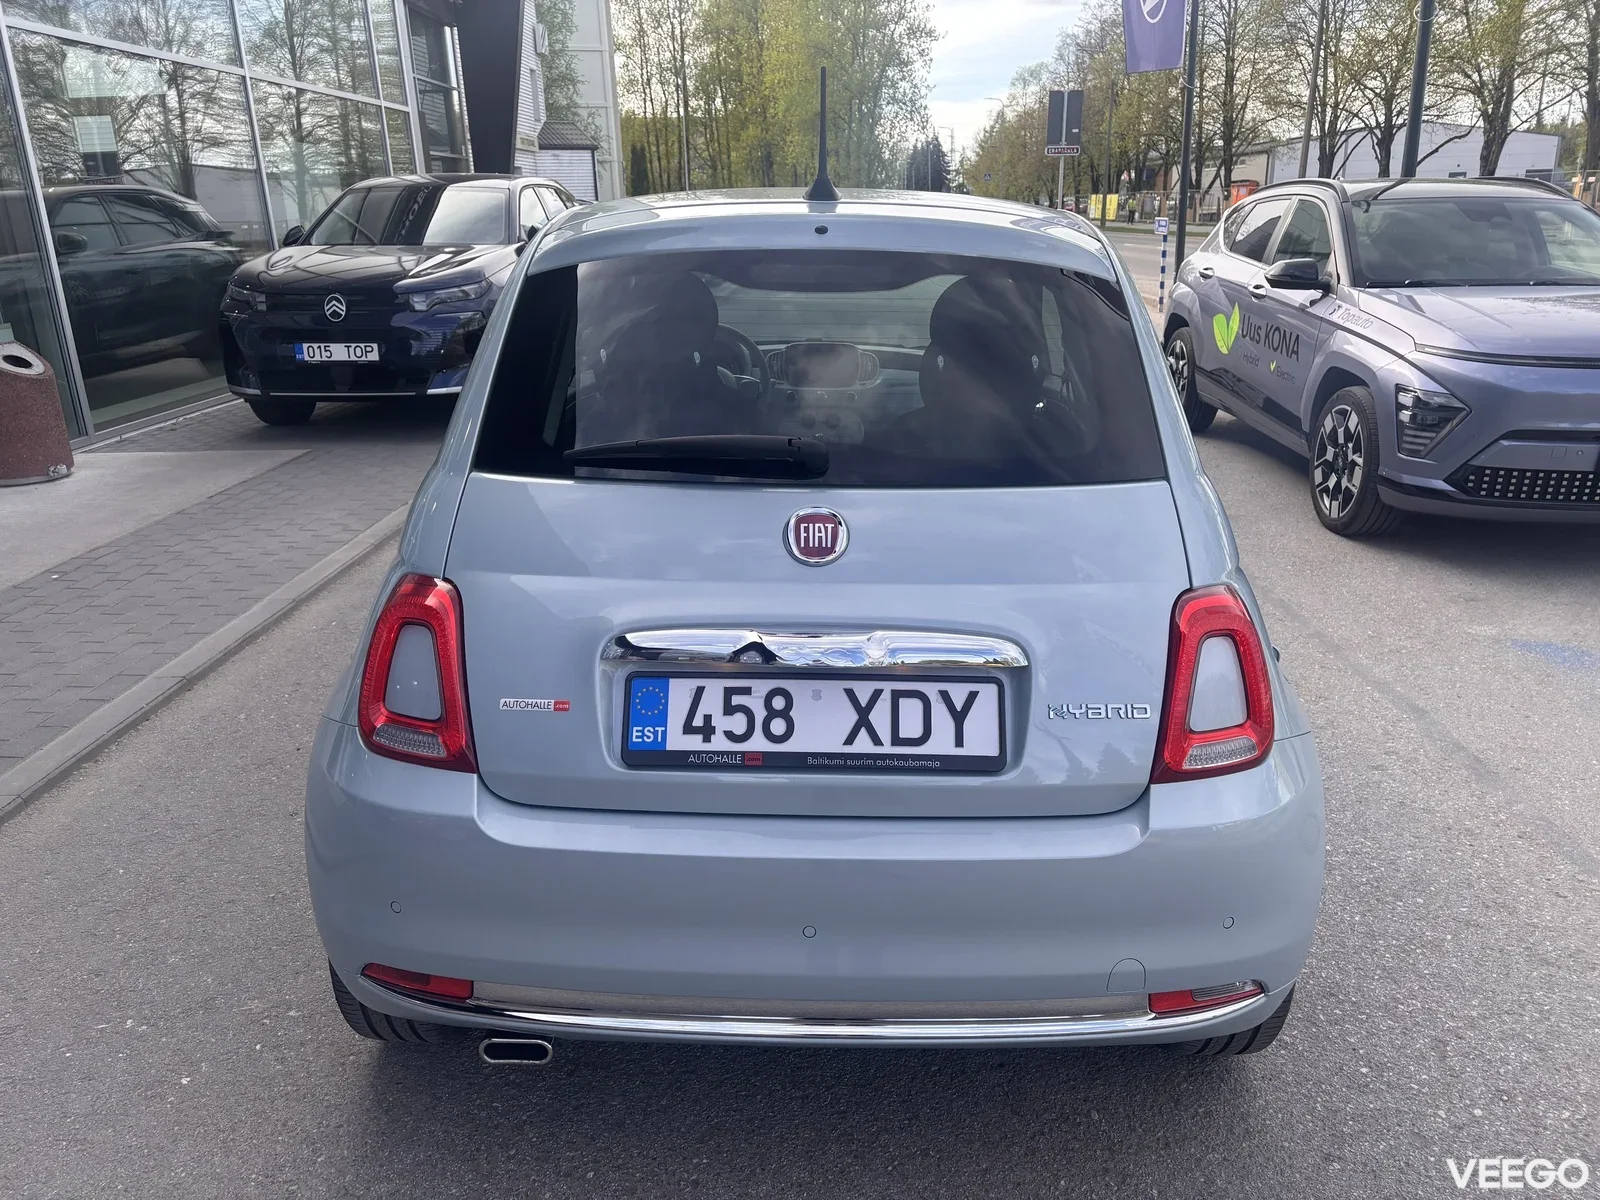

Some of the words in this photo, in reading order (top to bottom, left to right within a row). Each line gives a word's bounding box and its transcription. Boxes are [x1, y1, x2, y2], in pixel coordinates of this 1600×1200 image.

[1338, 308, 1374, 330] Topauto
[1241, 313, 1262, 345] Uus
[1264, 322, 1299, 362] KONA
[306, 345, 333, 359] 015
[344, 345, 374, 359] TOP
[800, 523, 835, 548] FIAT
[682, 685, 795, 744] 458
[842, 687, 980, 748] XDY
[1048, 703, 1151, 719] HYBRID
[632, 726, 665, 742] EST
[687, 753, 742, 764] AUTOHALLE
[807, 756, 845, 765] Baltikumi
[846, 758, 874, 766] suurim
[876, 758, 940, 769] autokaubamaja
